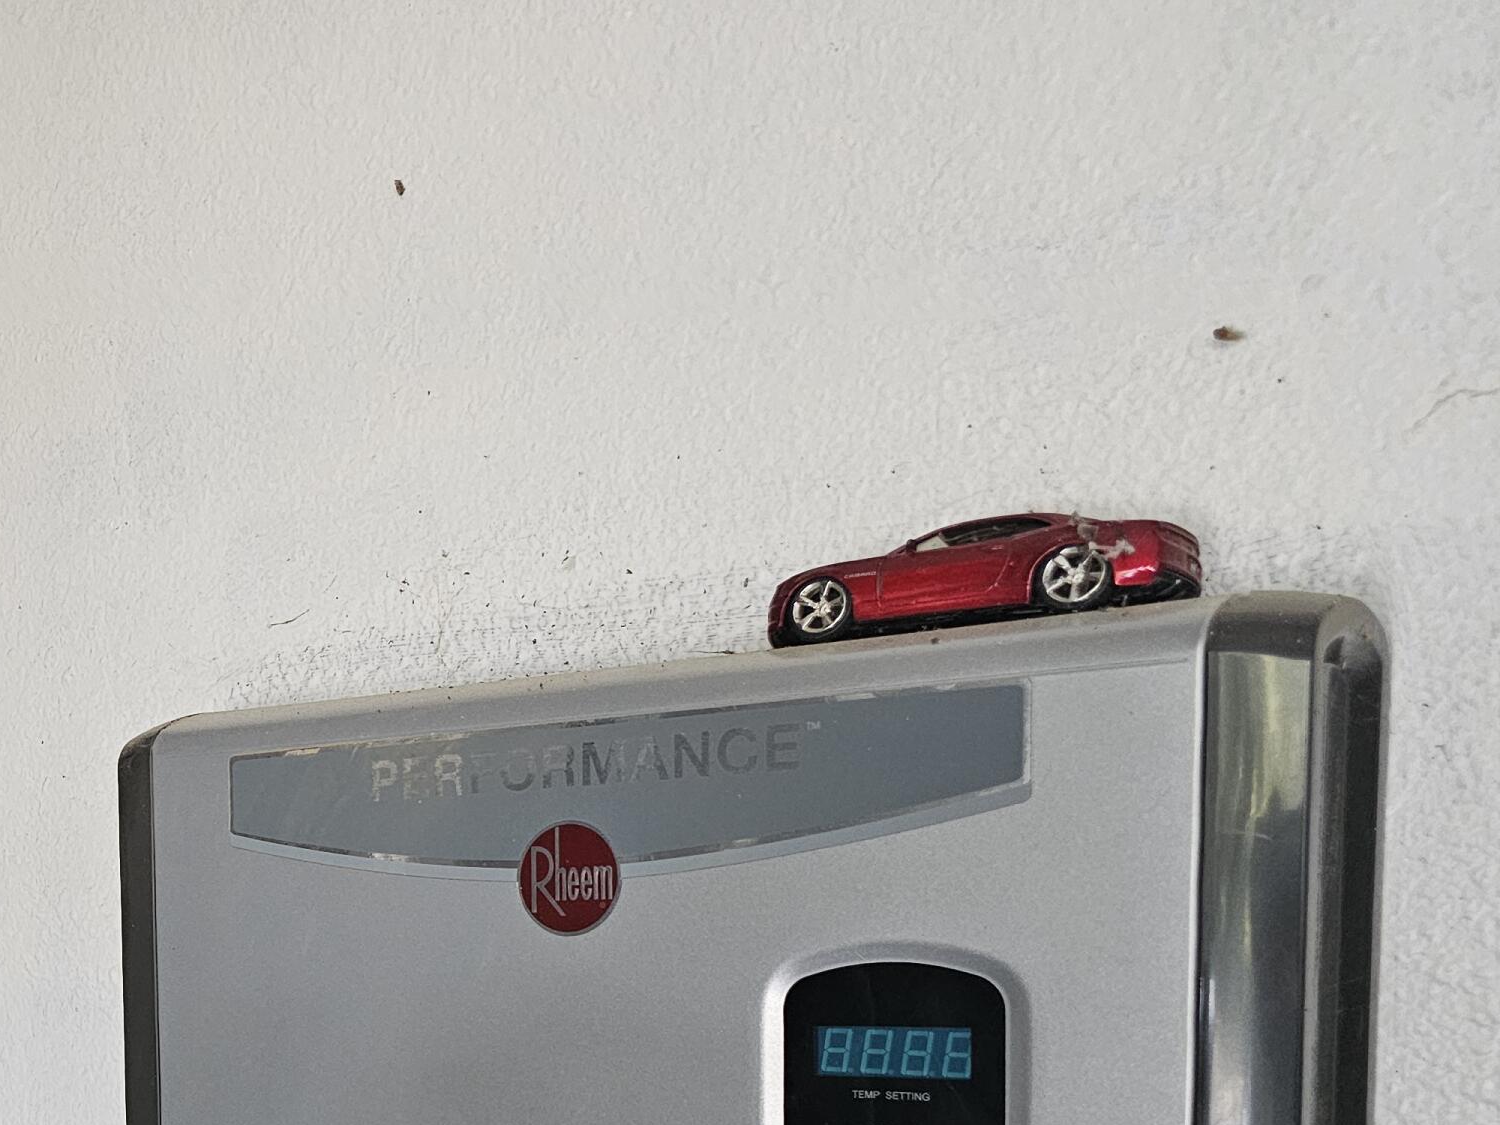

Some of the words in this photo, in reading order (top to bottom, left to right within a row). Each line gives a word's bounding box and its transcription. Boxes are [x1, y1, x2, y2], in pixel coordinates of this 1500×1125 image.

[530, 826, 613, 917] Rheem
[852, 1090, 881, 1099] TEMP
[885, 1091, 931, 1102] SETTING
